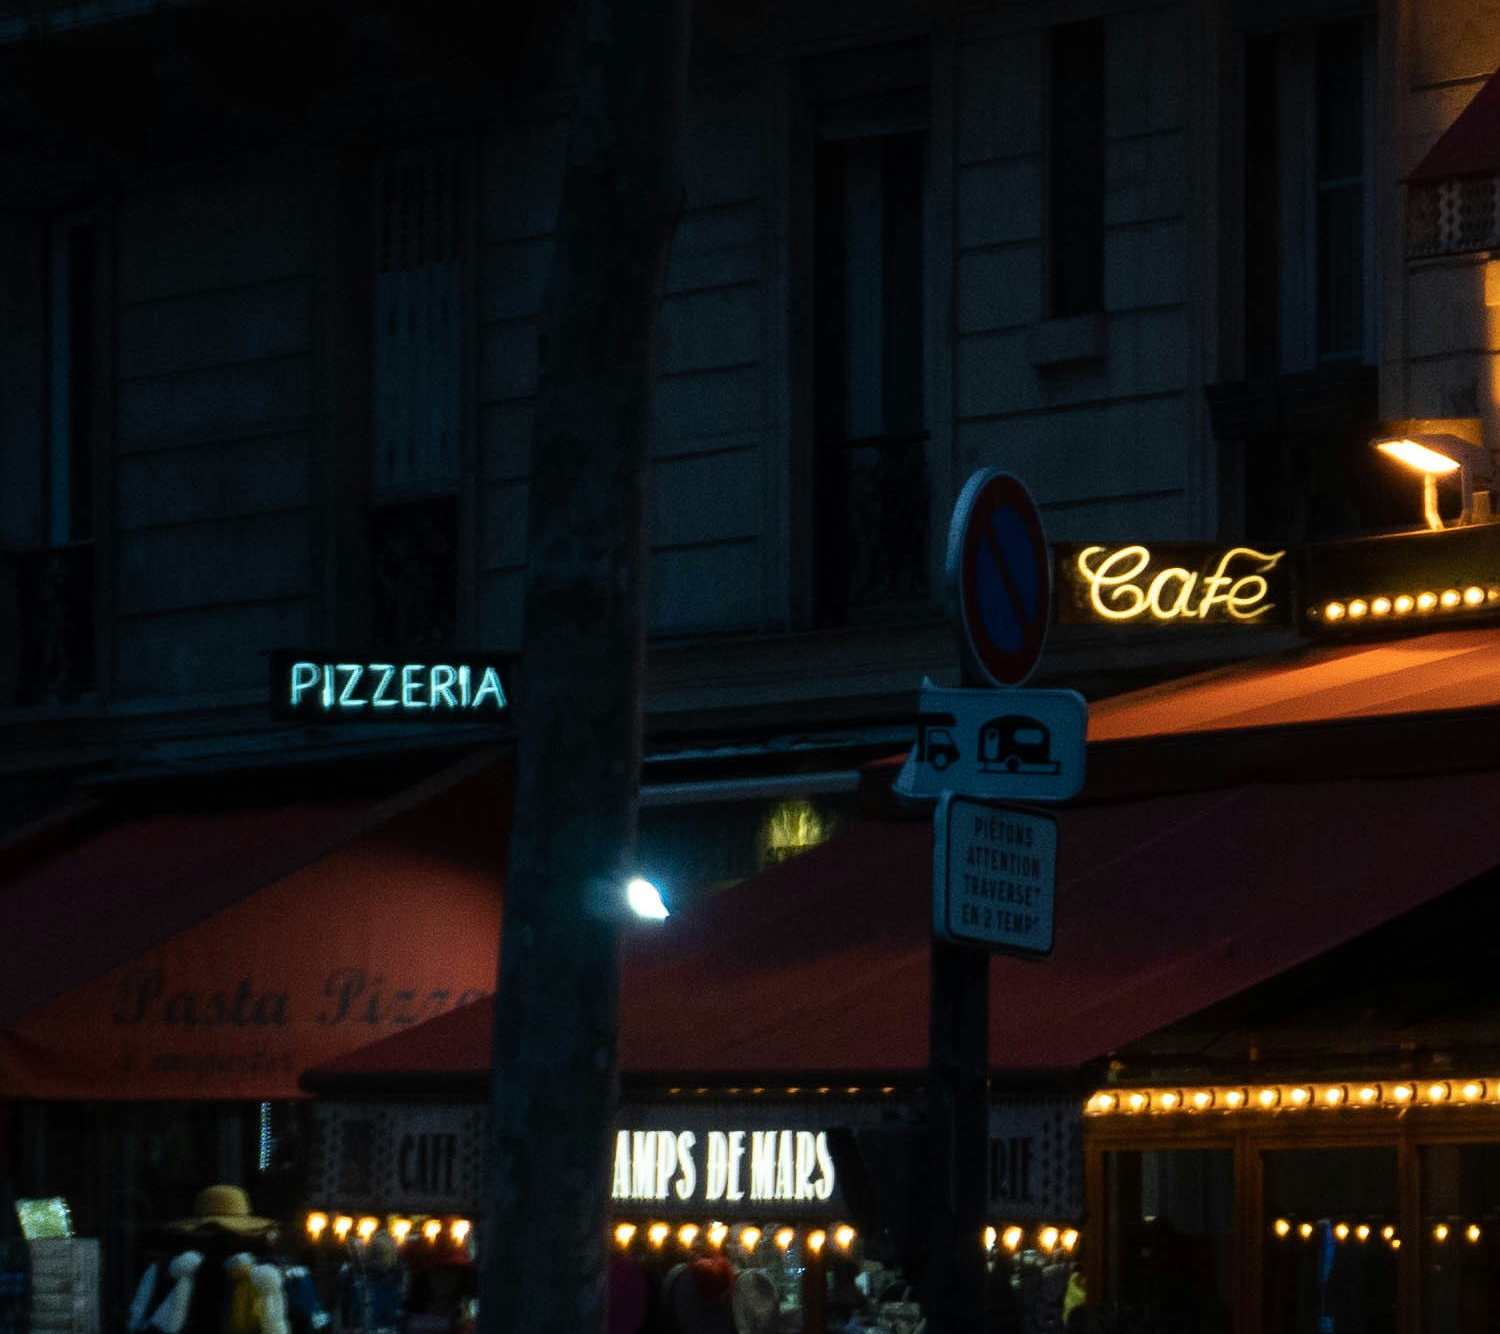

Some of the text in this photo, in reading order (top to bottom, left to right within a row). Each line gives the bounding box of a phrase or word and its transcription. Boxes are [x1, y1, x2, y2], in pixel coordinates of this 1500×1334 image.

[1077, 545, 1287, 620] Café
[289, 662, 507, 708] PIZZERIA
[966, 844, 1041, 880] ATTENTION
[113, 966, 291, 1028] Pasta
[611, 1130, 835, 1201] AMPS DE MARS
